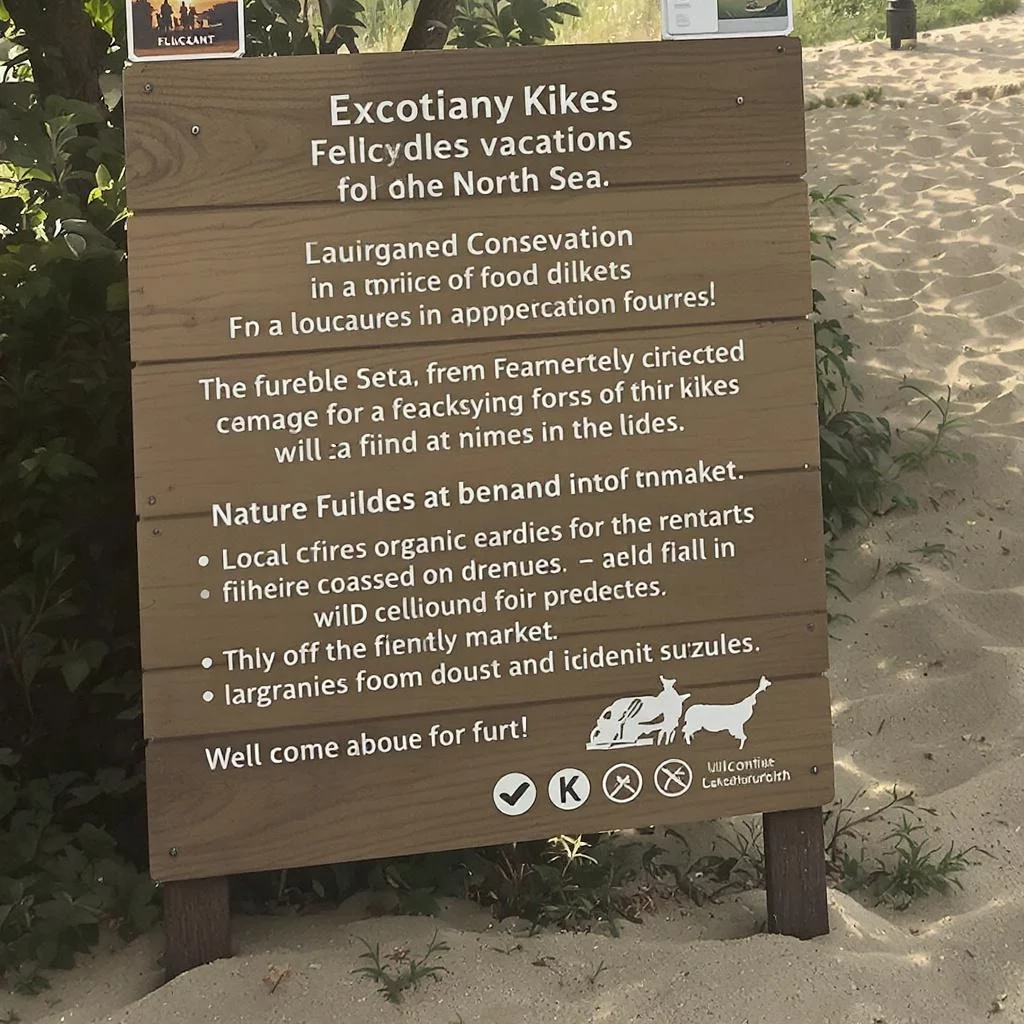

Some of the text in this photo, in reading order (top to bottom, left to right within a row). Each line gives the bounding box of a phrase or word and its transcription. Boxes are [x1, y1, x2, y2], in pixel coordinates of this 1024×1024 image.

[330, 83, 618, 127] Excotiany Kikes
[479, 124, 633, 157] vacations
[452, 166, 540, 198] North
[549, 165, 609, 191] Sea.
[466, 225, 633, 256] Consevation
[310, 276, 334, 299] in
[342, 280, 357, 298] a
[447, 265, 476, 291] of
[479, 262, 539, 289] food
[546, 259, 632, 285] dilkets
[268, 319, 284, 337] a
[291, 303, 412, 336] loucaures
[419, 303, 442, 326] in
[622, 280, 716, 313] fourres!
[198, 376, 247, 401] The
[253, 367, 348, 398] fureble
[356, 367, 419, 395] Seta,
[425, 361, 486, 385] frem
[325, 401, 365, 427] for
[370, 405, 385, 423] a
[391, 388, 524, 421] feacksying
[531, 387, 593, 411] forss
[598, 380, 626, 405] of
[630, 378, 674, 402] thir
[679, 374, 740, 400] kikes
[273, 434, 322, 464] will
[425, 432, 451, 452] at
[459, 425, 534, 449] nimes
[541, 421, 564, 443] in
[572, 417, 613, 440] the
[619, 411, 685, 436] lides.
[211, 501, 308, 528] Nature
[423, 485, 451, 509] at
[458, 473, 561, 505] benand
[569, 466, 630, 495] intof
[222, 543, 289, 571] Local
[374, 529, 468, 561] organic
[473, 521, 563, 548] eardies
[569, 516, 605, 540] for
[610, 513, 653, 536] the
[659, 504, 755, 532] rentarts
[317, 564, 416, 596] coassed
[423, 567, 453, 586] on
[461, 555, 568, 582] drenues.
[713, 537, 735, 559] in
[494, 588, 537, 612] foir
[543, 579, 667, 612] predectes.
[283, 640, 321, 667] off
[325, 639, 368, 662] the
[465, 620, 559, 649] market.
[354, 669, 423, 693] foom
[430, 659, 502, 686] doust
[508, 650, 555, 677] and
[204, 715, 528, 771] Well come aboue for furt!
[558, 775, 582, 804] K
